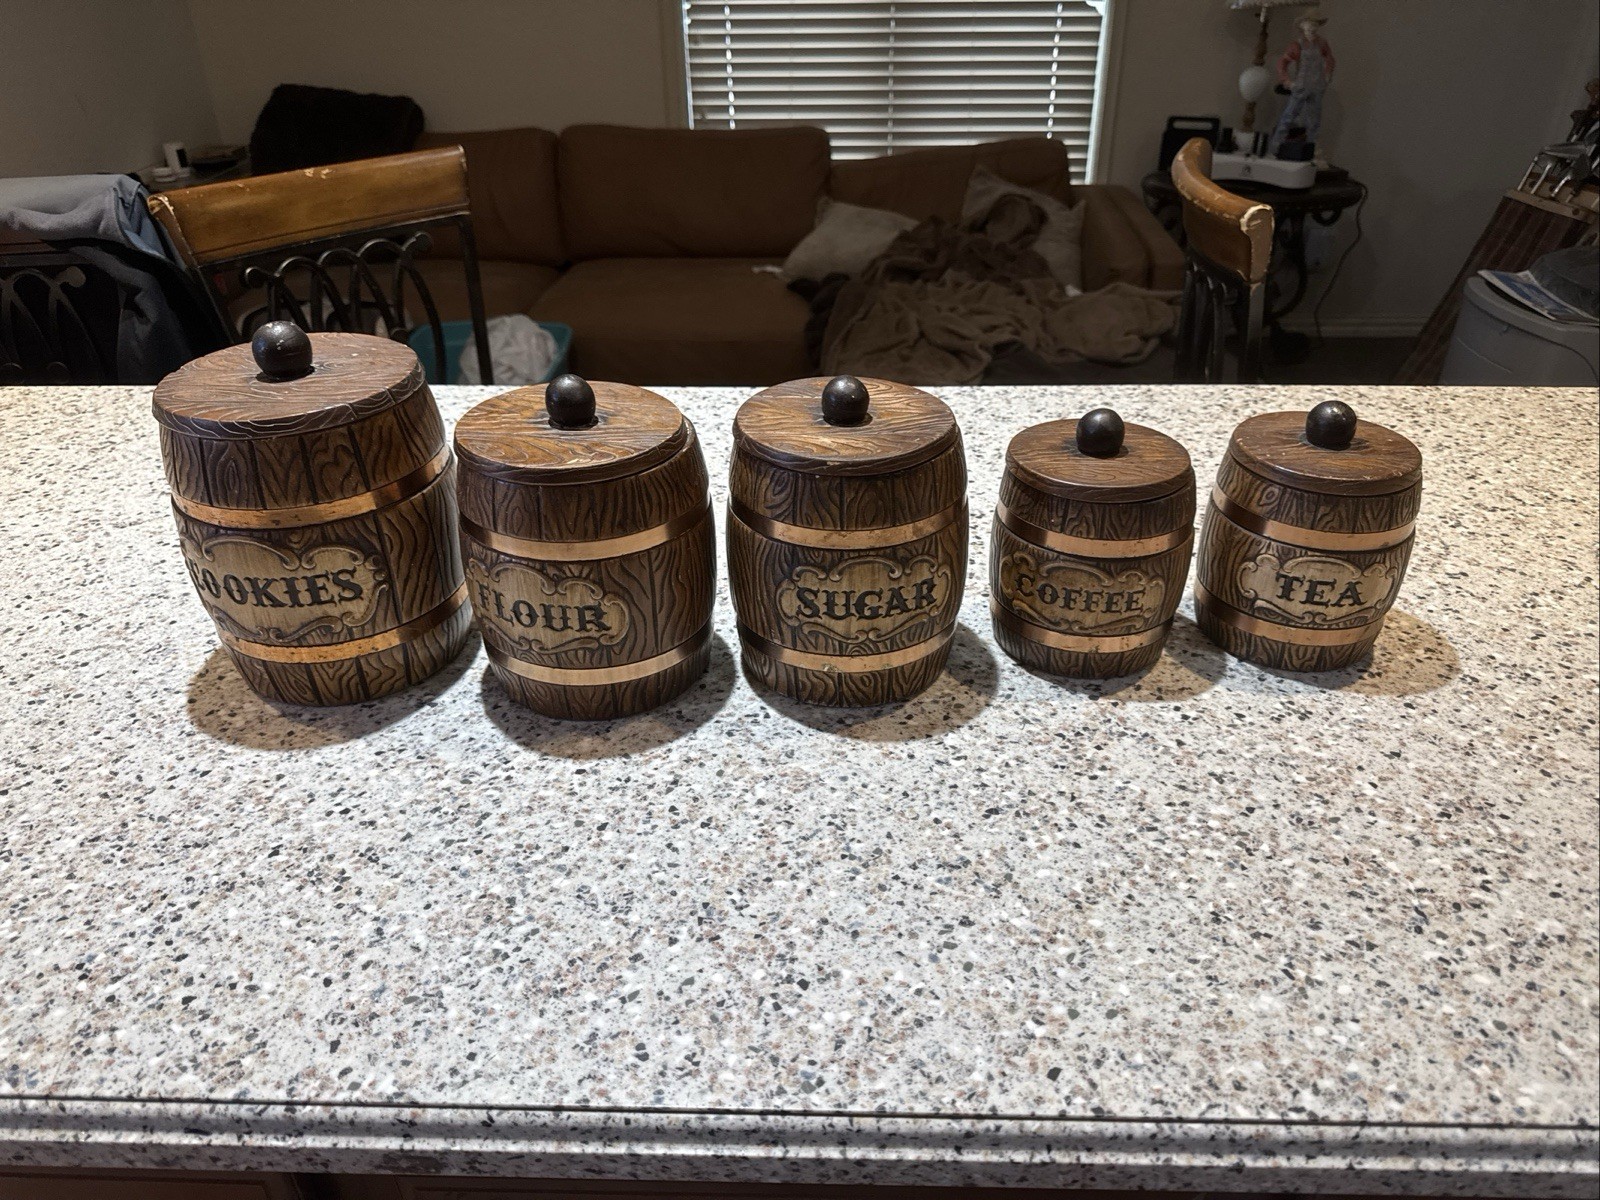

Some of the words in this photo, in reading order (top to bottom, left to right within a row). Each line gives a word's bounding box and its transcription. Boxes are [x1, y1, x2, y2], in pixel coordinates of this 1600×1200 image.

[477, 580, 612, 632] FLOUR
[796, 577, 937, 621] SUGAR
[1014, 573, 1147, 614] COFFEE
[1275, 572, 1368, 609] TEA
